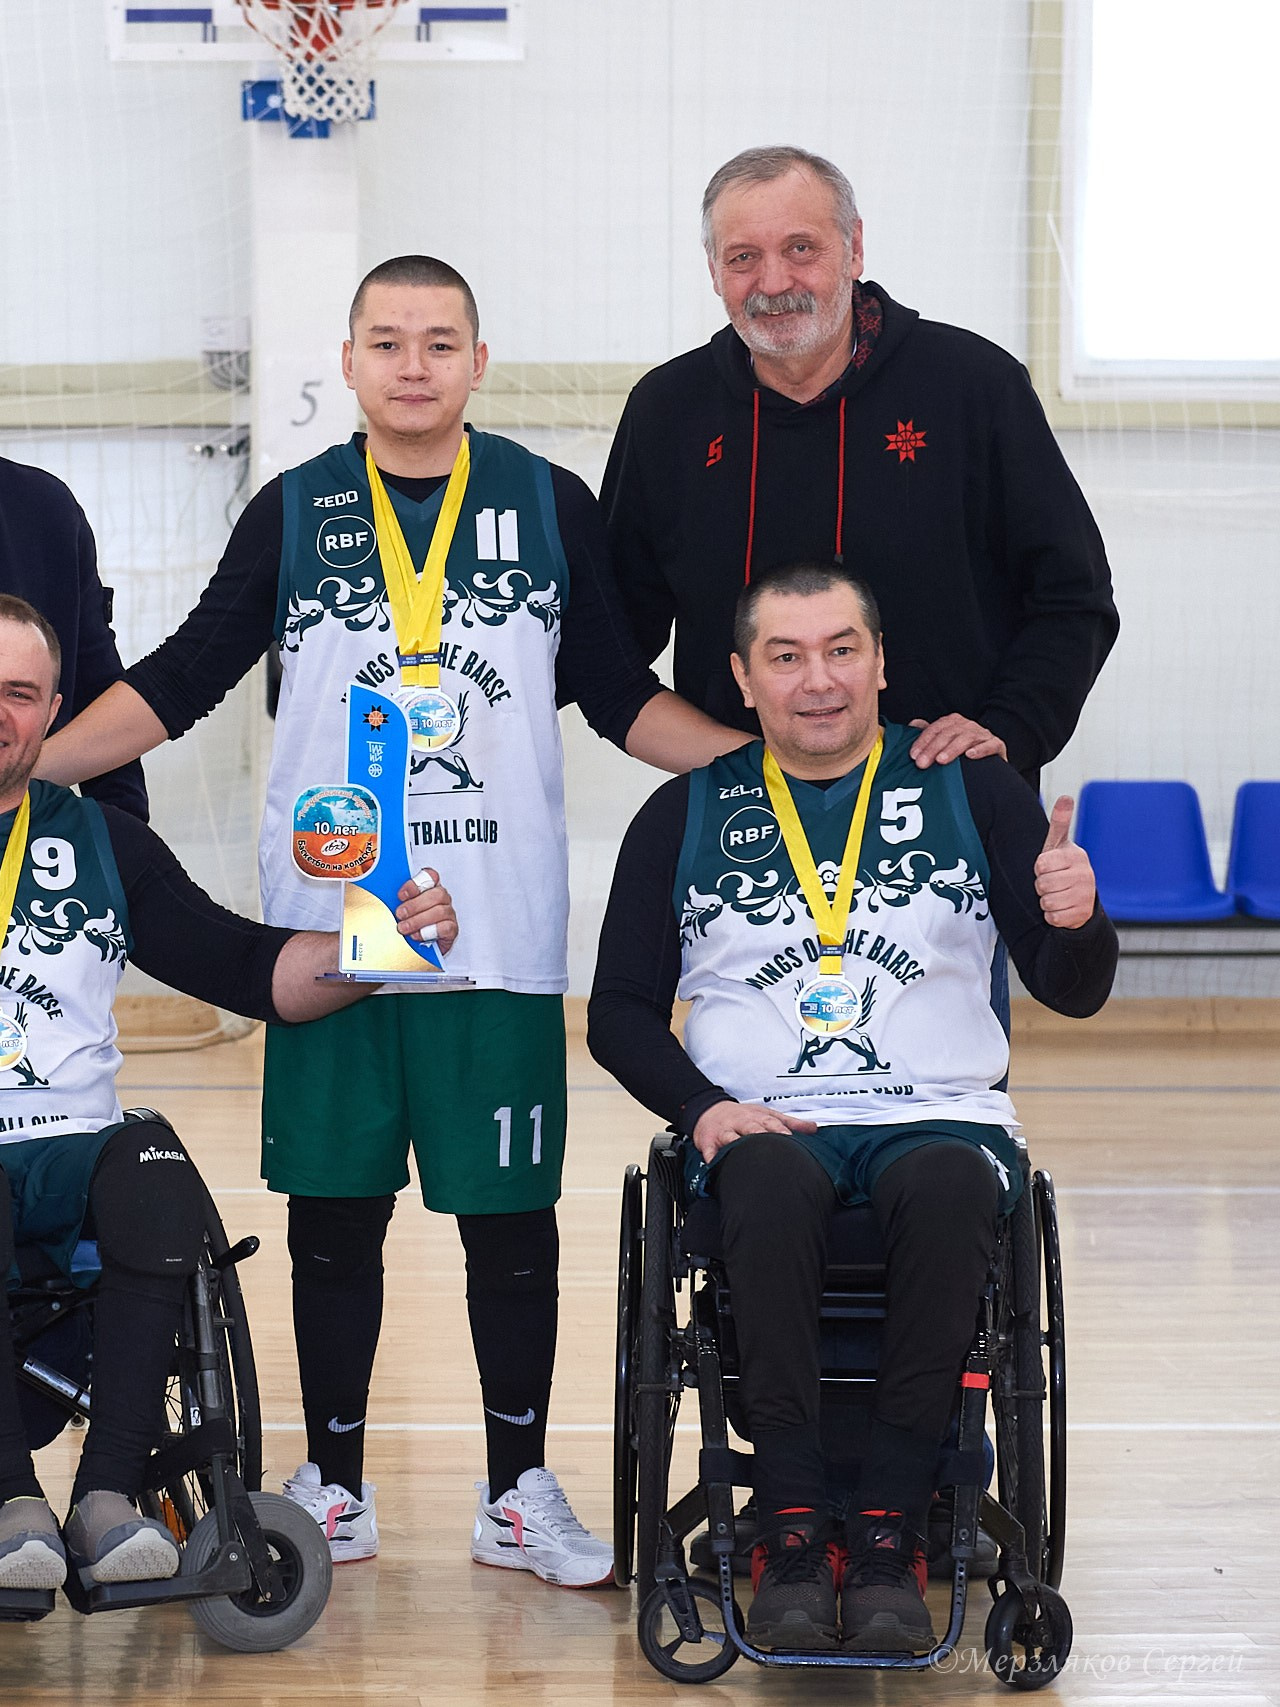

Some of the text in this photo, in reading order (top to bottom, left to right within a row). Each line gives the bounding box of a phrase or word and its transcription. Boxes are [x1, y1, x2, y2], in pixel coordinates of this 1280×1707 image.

[290, 379, 323, 427] 5
[312, 490, 359, 509] ZEDO
[324, 530, 369, 553] RBF
[474, 507, 520, 563] 11
[341, 653, 395, 704] NGS
[439, 642, 463, 671] HE
[460, 650, 512, 708] BARSE
[422, 719, 433, 728] 10
[314, 822, 359, 835] 10 лет
[465, 818, 499, 844] CLUB
[879, 787, 924, 845] 5
[729, 824, 775, 847] RBF
[30, 836, 77, 891] 9
[297, 840, 330, 870] Баскетбол
[344, 842, 373, 869] колясках
[844, 928, 870, 956] HE
[866, 934, 926, 986] BARSE
[15, 974, 64, 1021] BARSE
[822, 1004, 833, 1013] 10
[493, 1104, 543, 1167] 11
